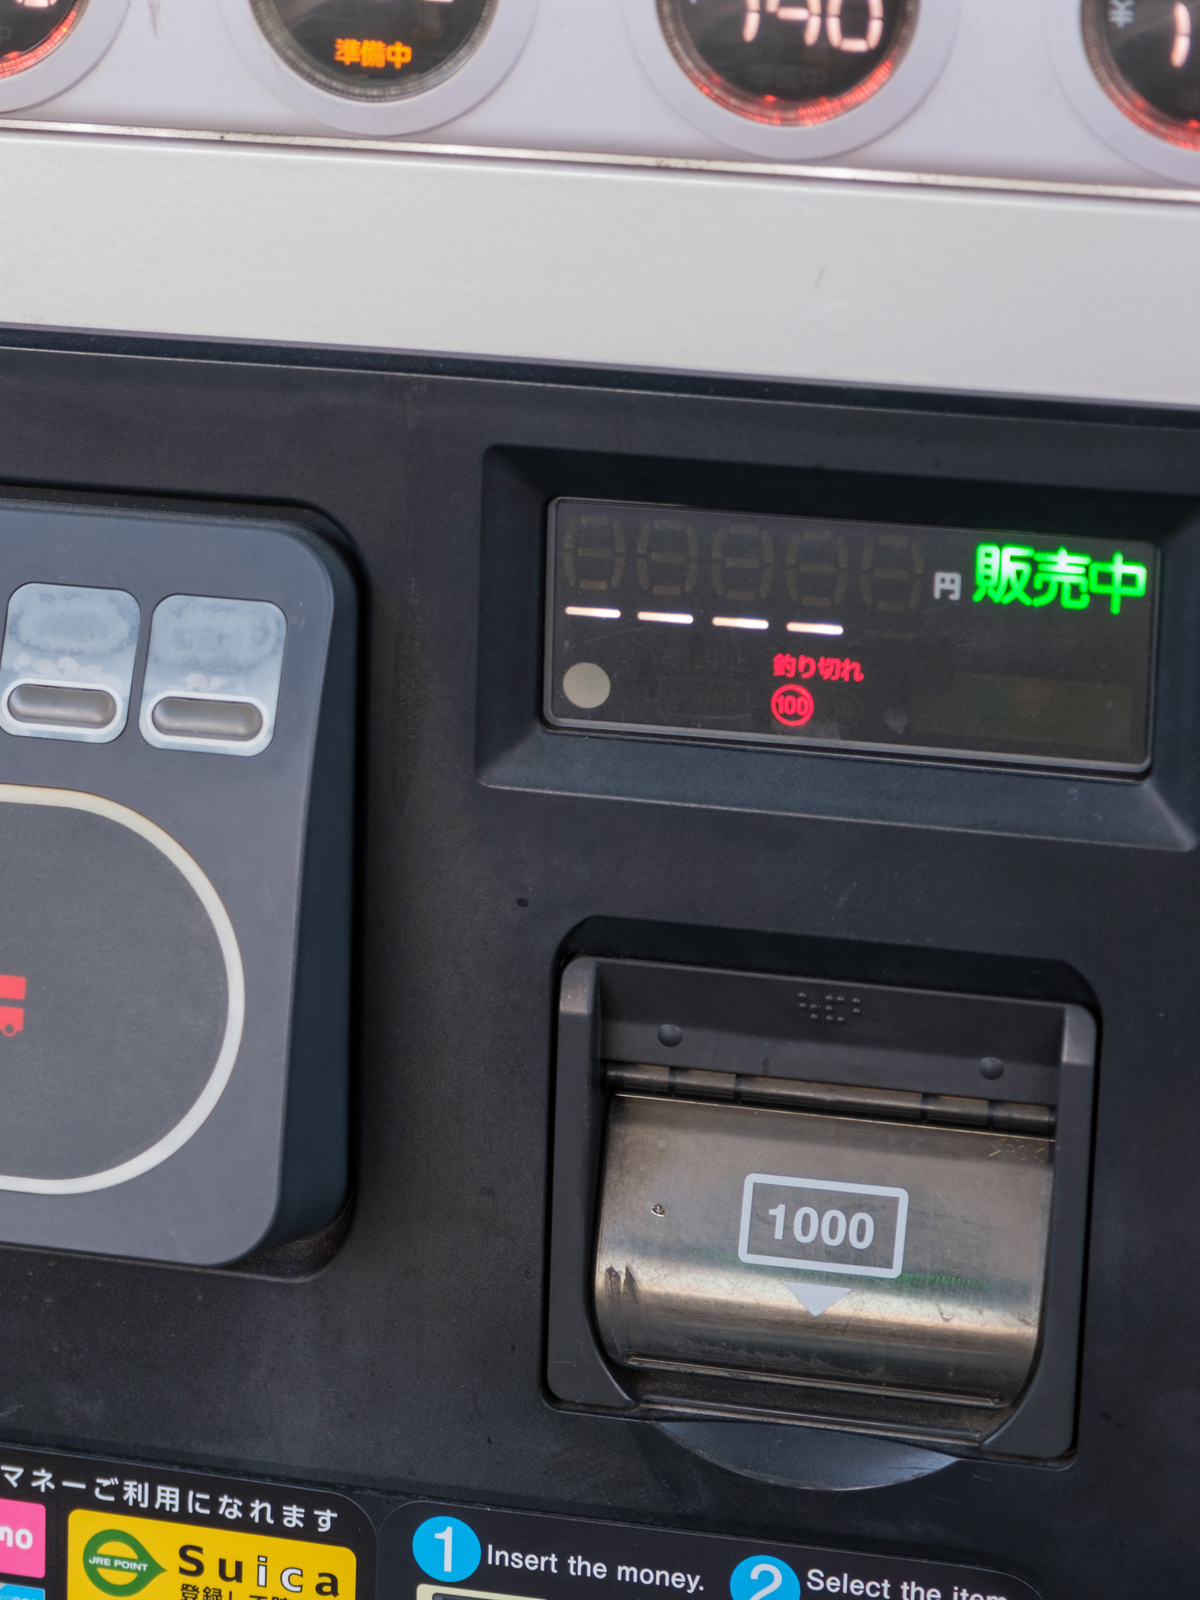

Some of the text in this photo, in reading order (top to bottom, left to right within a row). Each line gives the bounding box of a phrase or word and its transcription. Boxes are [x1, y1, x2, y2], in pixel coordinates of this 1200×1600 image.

[334, 38, 412, 69] 準備中
[933, 571, 962, 601] 円
[971, 543, 1148, 615] 販売中
[773, 653, 865, 682] 釣り切れ
[776, 695, 809, 717] 100
[768, 1203, 875, 1250] 1000
[87, 1554, 150, 1572] JRE POINT
[178, 1544, 341, 1598] Suica
[434, 1526, 705, 1594] 1 Insert the money.
[749, 1563, 783, 1600] 2
[806, 1568, 891, 1599] Select
[900, 1581, 942, 1600] the
